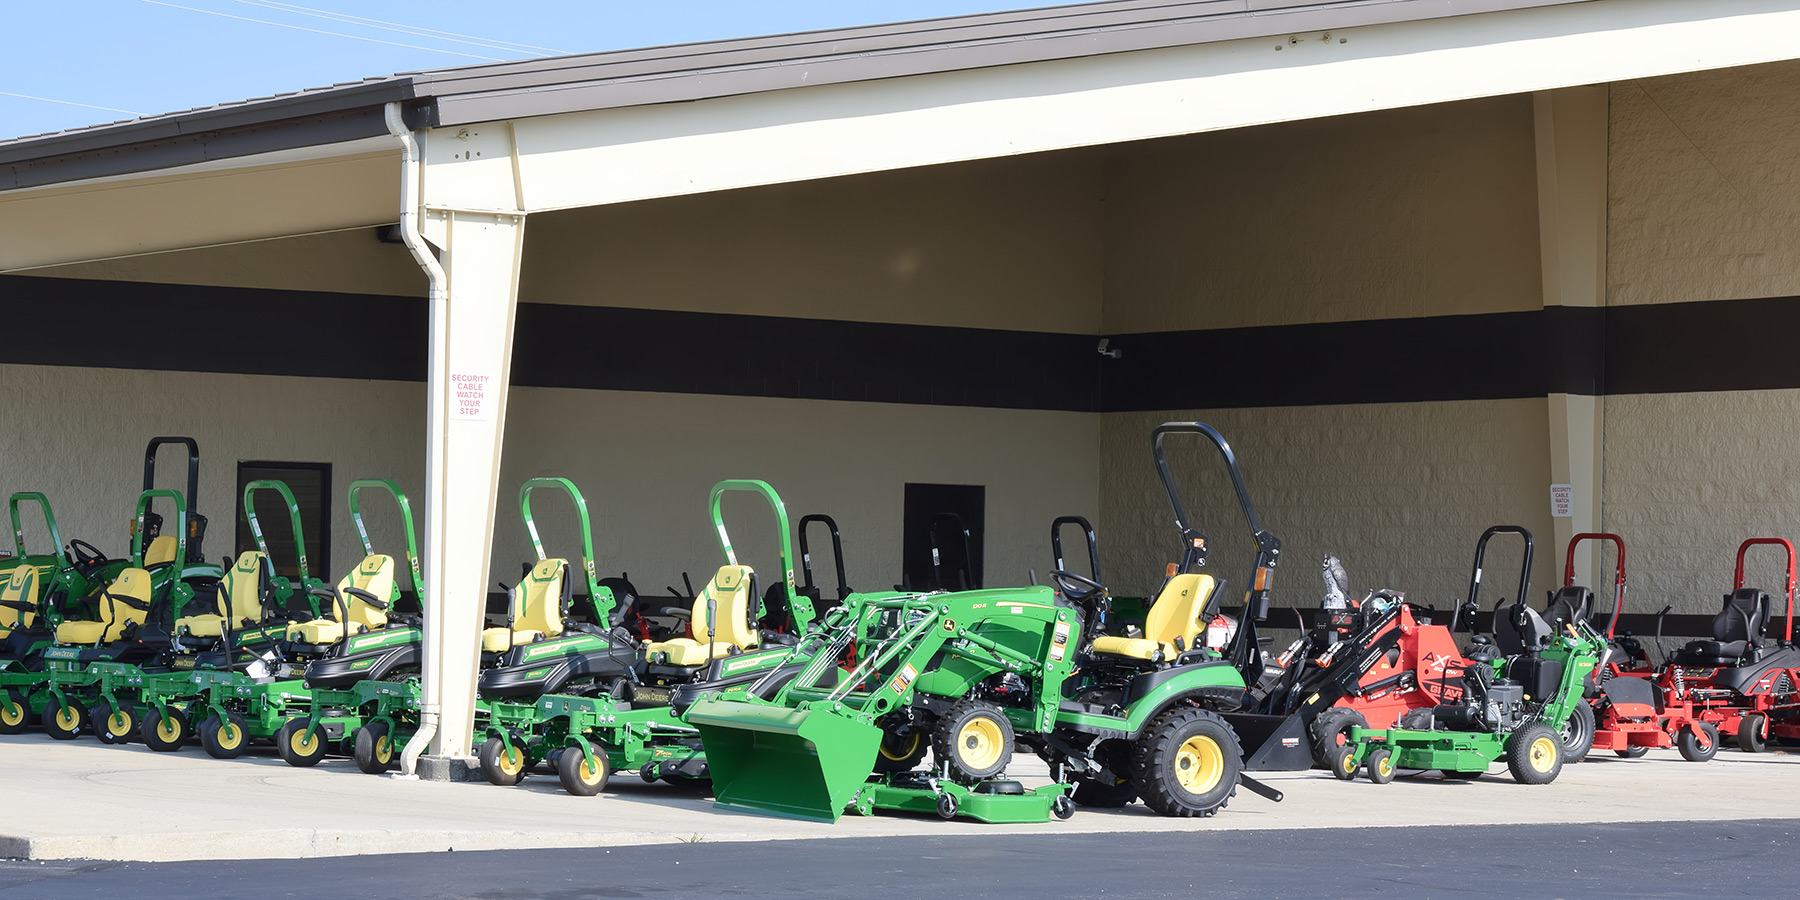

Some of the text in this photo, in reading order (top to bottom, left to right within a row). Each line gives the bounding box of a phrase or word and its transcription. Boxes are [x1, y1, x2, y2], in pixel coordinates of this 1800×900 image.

[451, 374, 489, 383] SECURITY
[457, 383, 483, 391] CABLE
[457, 391, 484, 399] WATCH
[636, 691, 669, 702] JOHN DEERE
